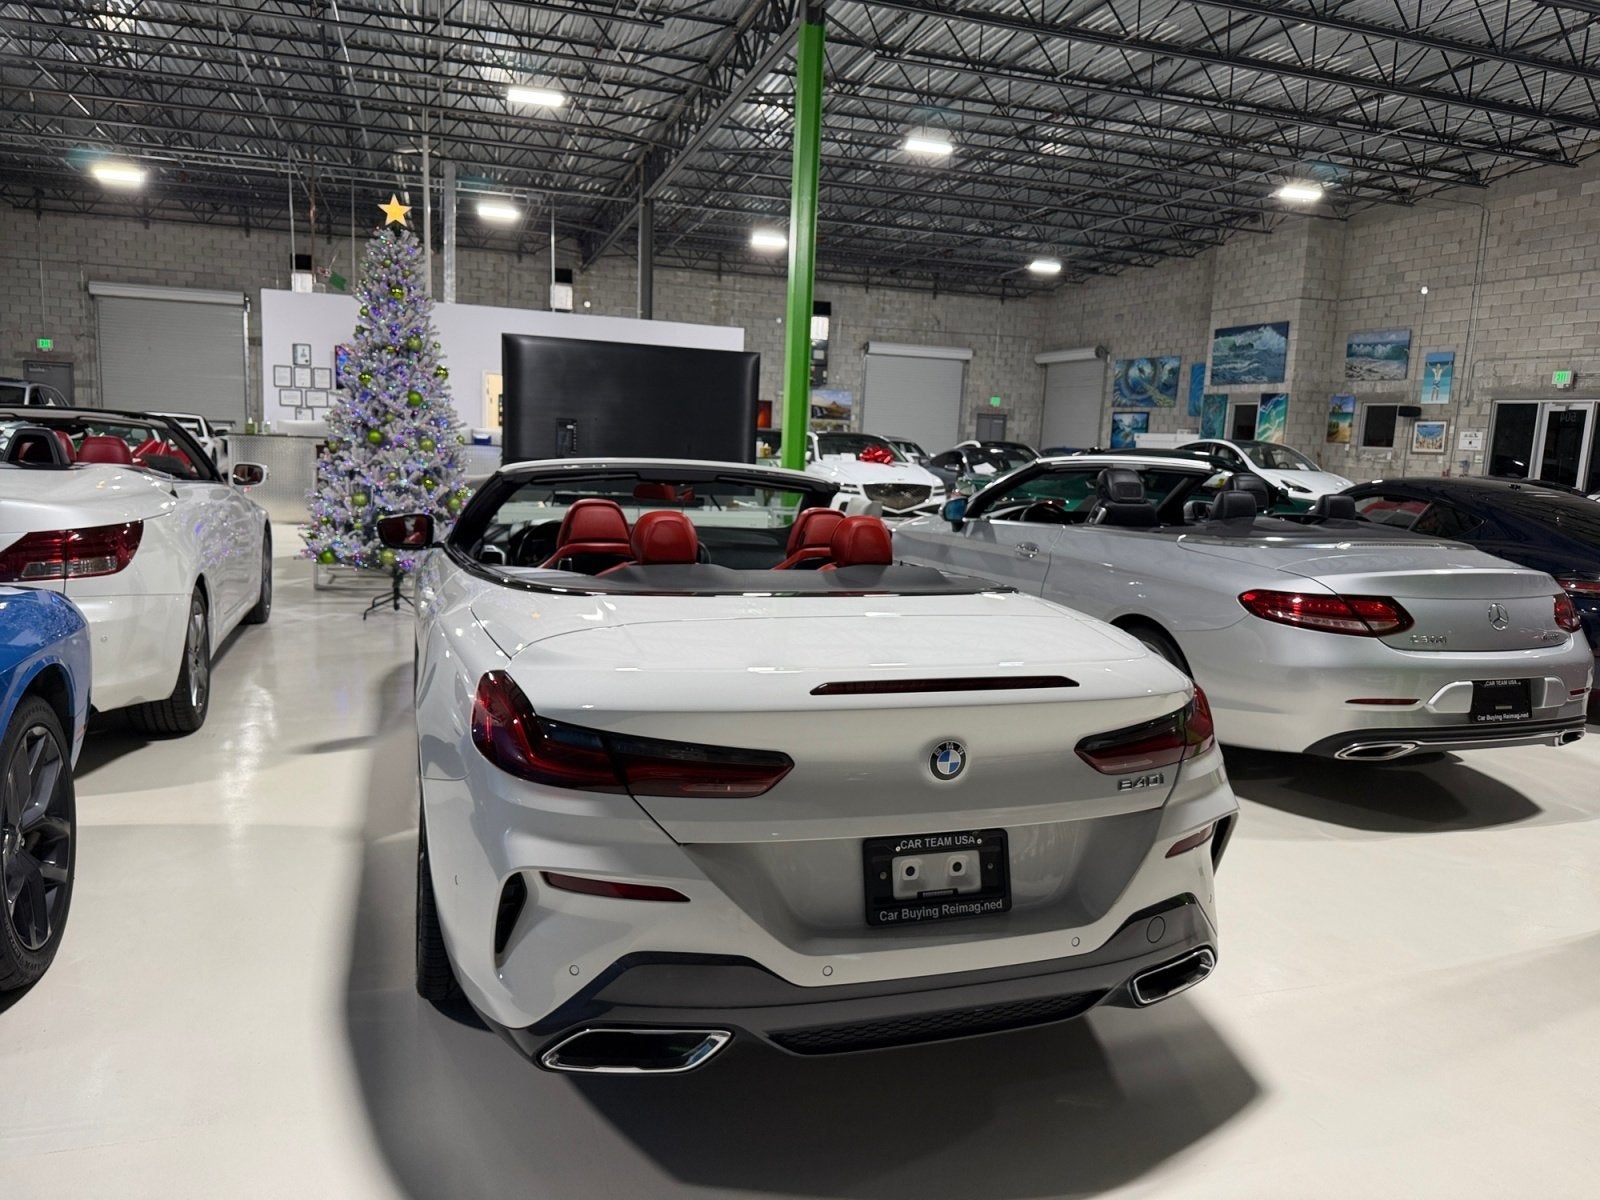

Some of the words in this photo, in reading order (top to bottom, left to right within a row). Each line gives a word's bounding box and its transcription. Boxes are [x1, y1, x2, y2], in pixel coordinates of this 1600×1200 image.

[932, 741, 965, 757] BMW
[900, 839, 922, 850] CAR
[924, 836, 953, 848] TEAM
[954, 835, 976, 846] USA
[879, 910, 899, 922] Car
[901, 905, 939, 920] Buying
